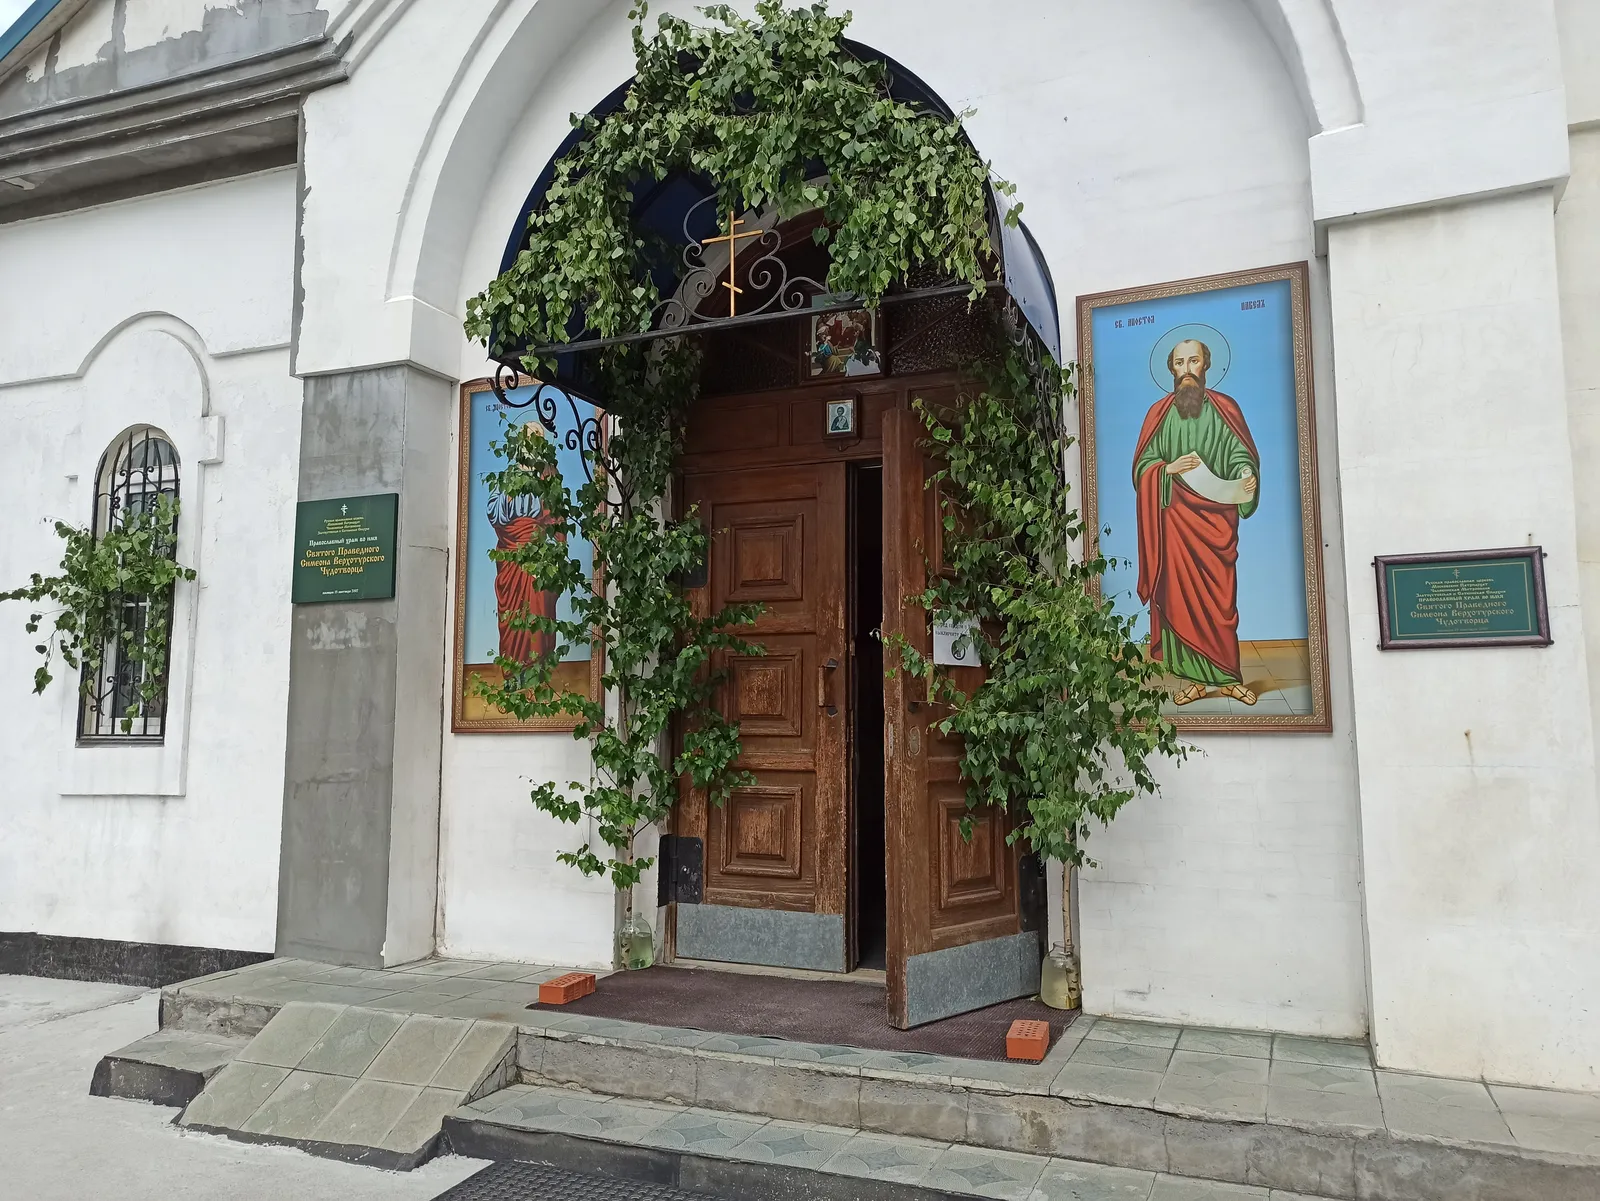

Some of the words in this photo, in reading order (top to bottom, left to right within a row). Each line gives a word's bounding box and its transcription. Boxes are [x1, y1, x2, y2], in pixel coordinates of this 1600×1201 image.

[306, 549, 336, 558] Святого
[338, 546, 380, 557] Праведного
[300, 559, 331, 568] Симеона
[333, 555, 385, 567] Верхотурского
[320, 566, 364, 577] Чудотворца
[1416, 602, 1453, 610] Святого
[1455, 601, 1507, 609] Праведного
[1410, 610, 1448, 618] Симеона
[1451, 608, 1515, 618] Верхотурского
[1435, 617, 1489, 627] Чудотворца
